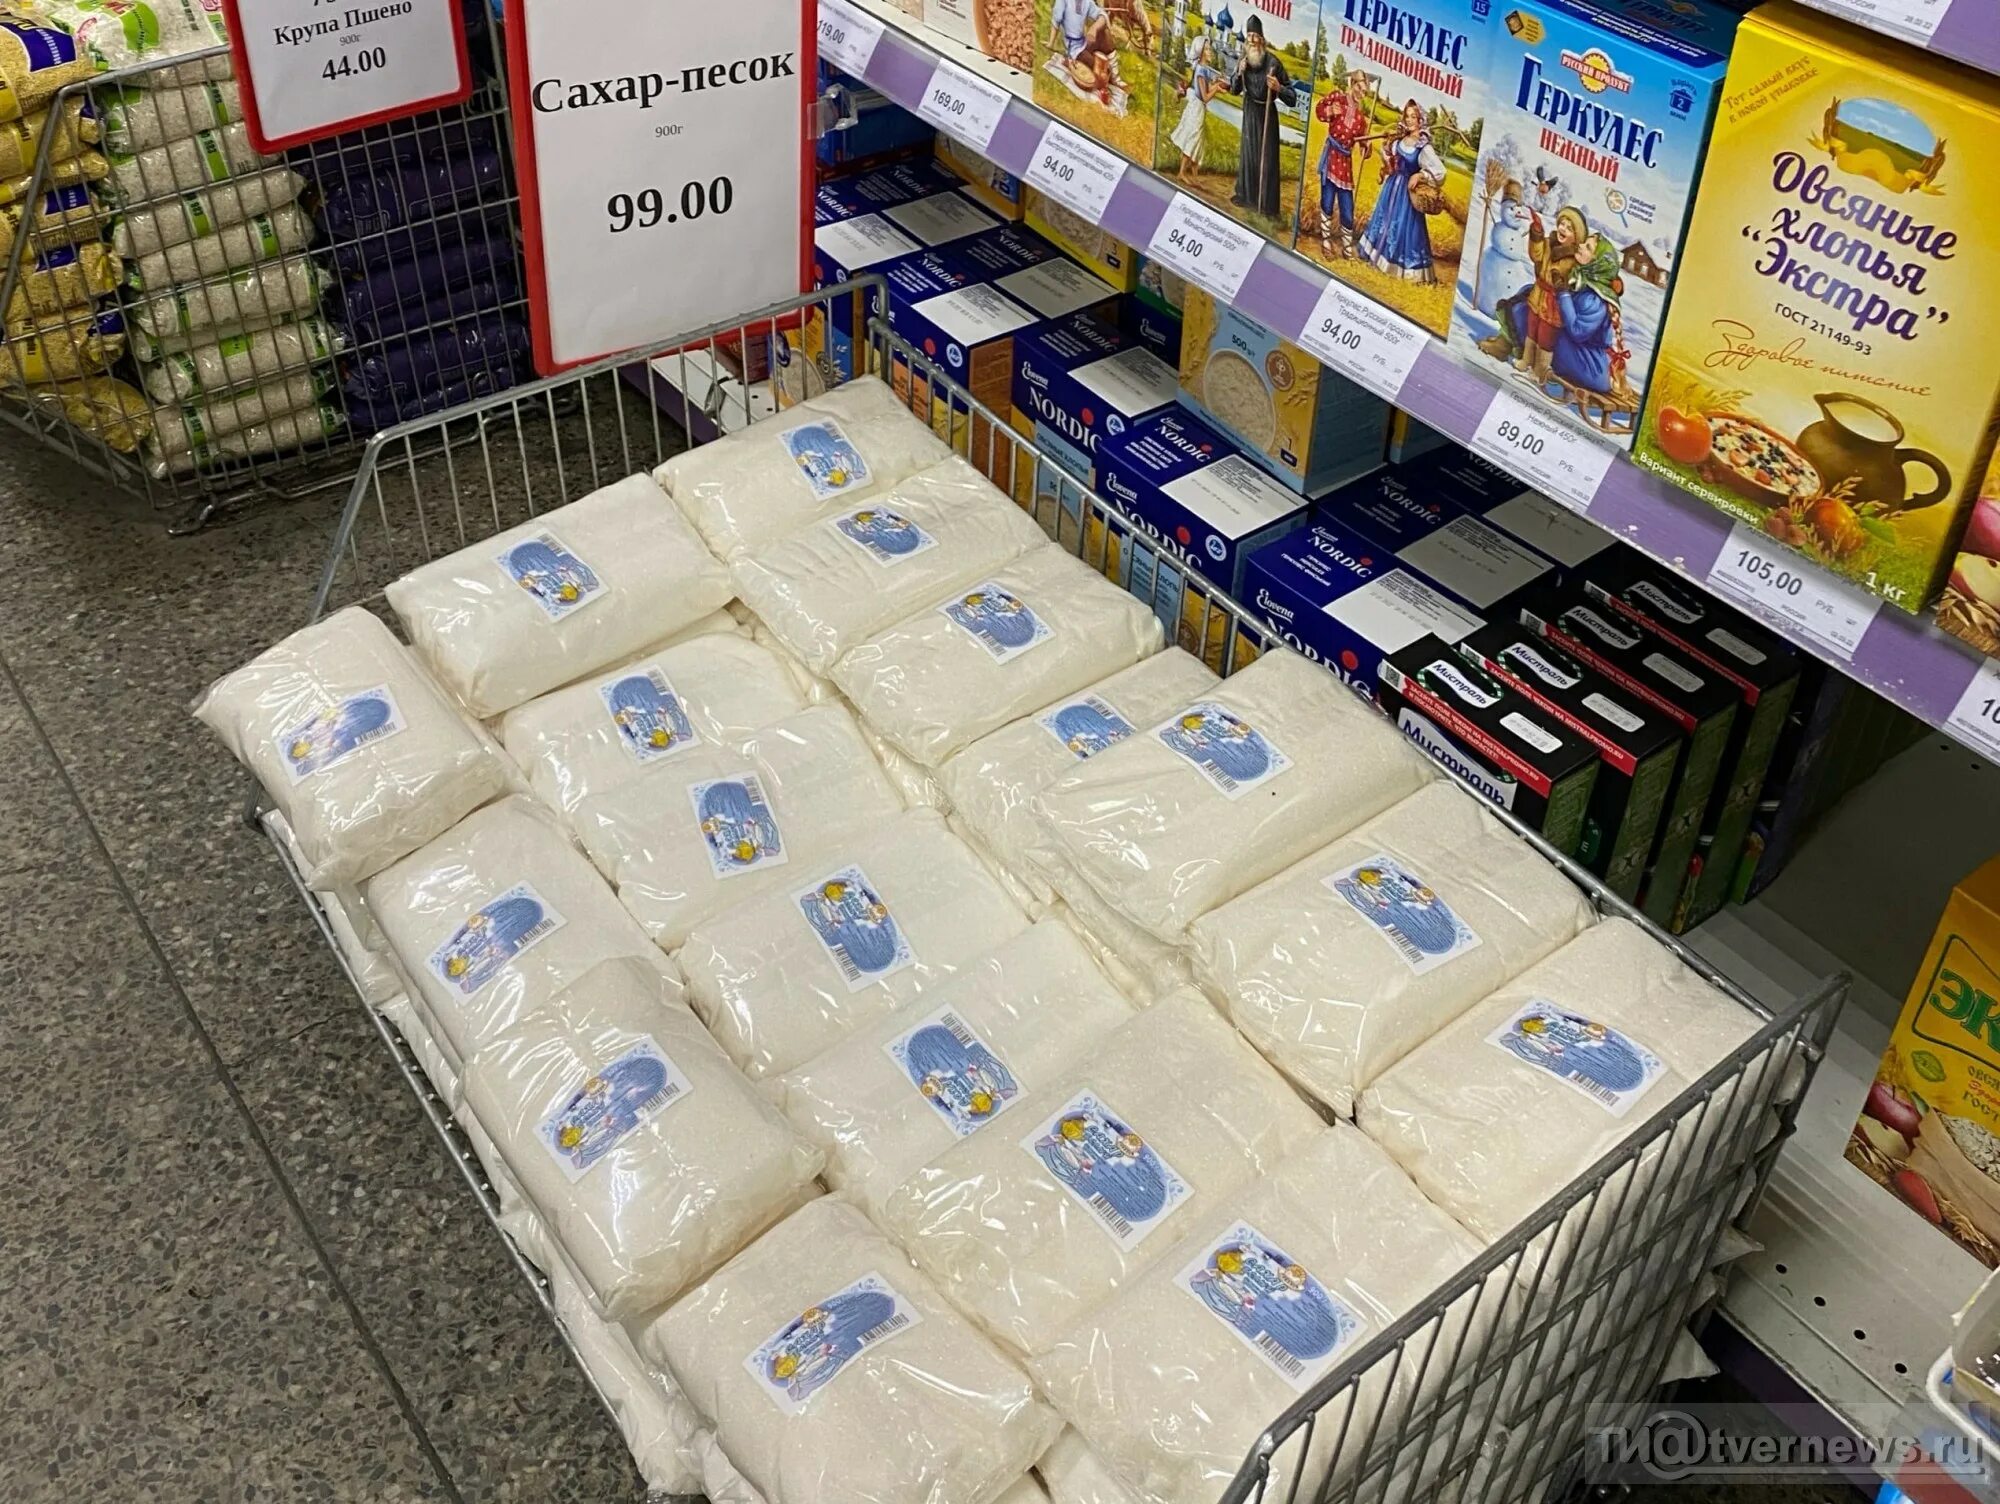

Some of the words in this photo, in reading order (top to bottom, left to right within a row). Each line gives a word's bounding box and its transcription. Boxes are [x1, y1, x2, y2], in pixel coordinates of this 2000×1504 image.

[273, 19, 341, 46] Крупа
[344, 1, 413, 29] Пшено
[1475, 1, 1486, 13] 15
[322, 47, 386, 81] 44.00
[1339, 23, 1464, 99] ТРАДИЦИОННЫЙ
[1561, 53, 1596, 79] РУССКИЙ
[1594, 67, 1631, 93] ПРОДУКТ
[532, 52, 795, 113] Сахар-песок
[933, 88, 966, 116] 169,00
[1678, 98, 1685, 110] 2
[655, 124, 683, 138] 900г
[1043, 155, 1074, 182] 94,00
[1538, 127, 1621, 183] НЕЖНЫЙ
[607, 176, 733, 233] 99.00
[816, 190, 855, 218] NORDIC
[1772, 151, 1958, 261] Овсяные
[1168, 229, 1203, 257] 94,00
[1771, 208, 1928, 295] хлопья
[918, 258, 962, 287] NORDIC
[1070, 320, 1119, 352] NORDIC
[1321, 318, 1361, 350] 94,00
[1774, 302, 1810, 327] ГОСТ
[1809, 320, 1873, 356] 21149-93
[1021, 361, 1049, 390] Elovena
[1703, 319, 1814, 371] Здоровое
[1819, 364, 1933, 397] питание
[1028, 387, 1104, 453] NORDIC
[1497, 420, 1544, 455] 89,00
[1154, 425, 1211, 464] NORDIC
[1106, 472, 1137, 504] Elovena
[1377, 484, 1442, 526] NORDIC
[1639, 451, 1688, 488] Вариант
[1686, 477, 1761, 526] сервировки
[1307, 535, 1373, 579] NORDIC
[1737, 550, 1803, 597] 105,00
[1864, 571, 1880, 588] 1
[1256, 588, 1295, 625] Elovena
[1635, 583, 1694, 623] Мистраль
[1571, 608, 1629, 648] Мистраль
[1432, 663, 1487, 706] Мистраль
[1511, 645, 1569, 688] Мистраль
